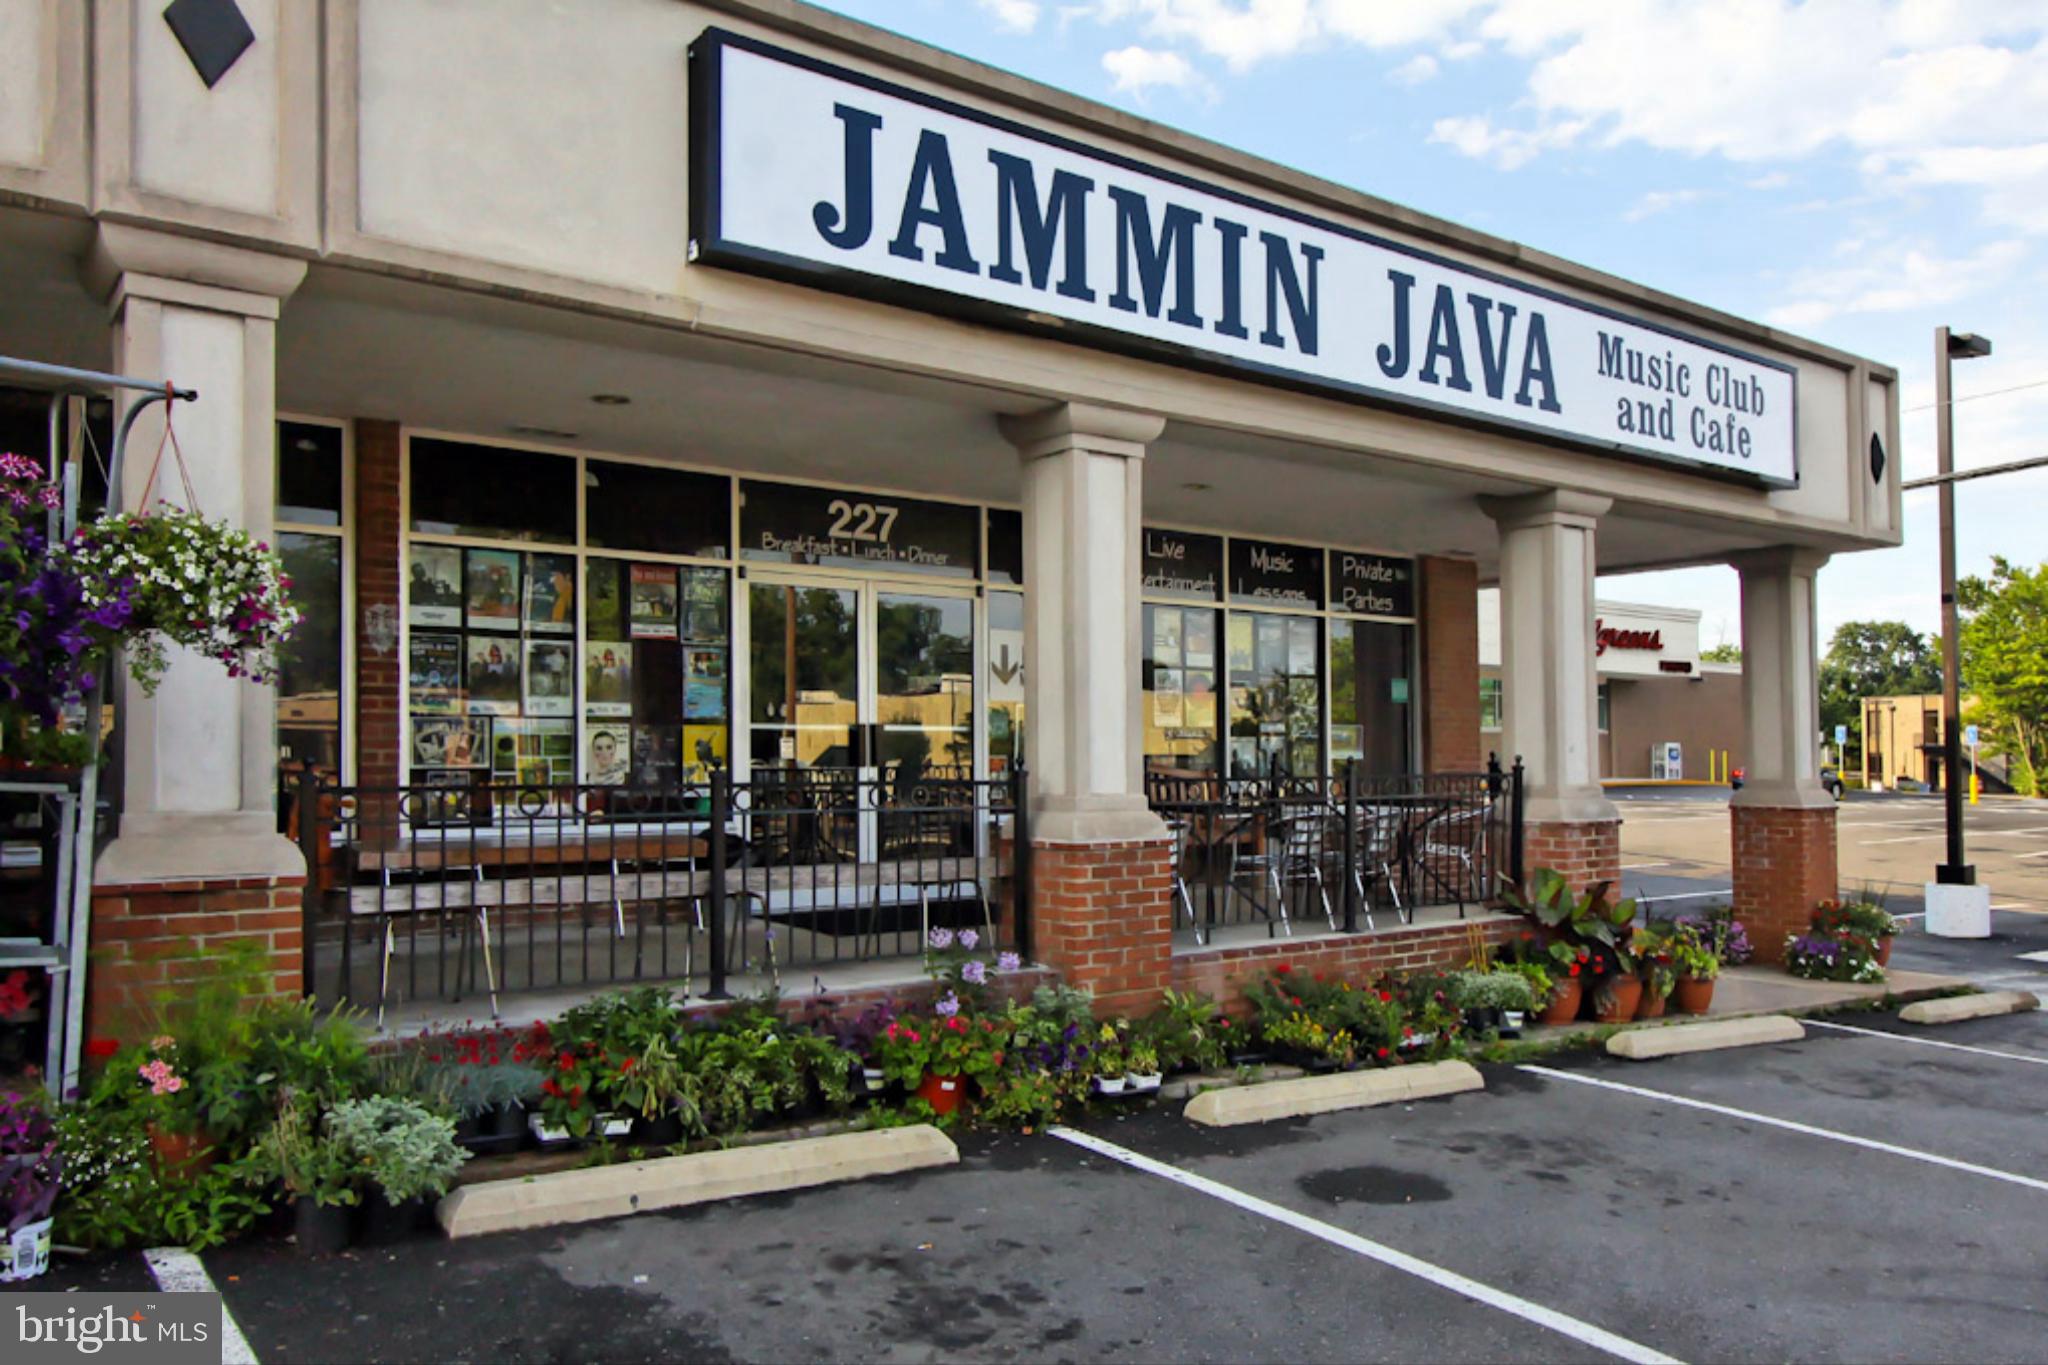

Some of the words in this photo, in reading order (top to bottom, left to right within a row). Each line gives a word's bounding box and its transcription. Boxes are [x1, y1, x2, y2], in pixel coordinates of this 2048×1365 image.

[812, 102, 1324, 356] JAMMIN
[1377, 268, 1562, 414] JAVA
[1597, 330, 1690, 398] Music
[1706, 363, 1764, 417] Club
[1617, 396, 1676, 442] and
[1690, 405, 1751, 459] Cafe
[827, 498, 899, 543] 227
[762, 529, 839, 555] Breakfast
[850, 539, 897, 562] Lunch
[908, 544, 949, 565] Dinner
[1147, 531, 1185, 559] Live
[1250, 545, 1294, 574] Music
[1343, 555, 1393, 582] Private
[1238, 577, 1307, 601] Lessons
[1343, 586, 1394, 611] Parties
